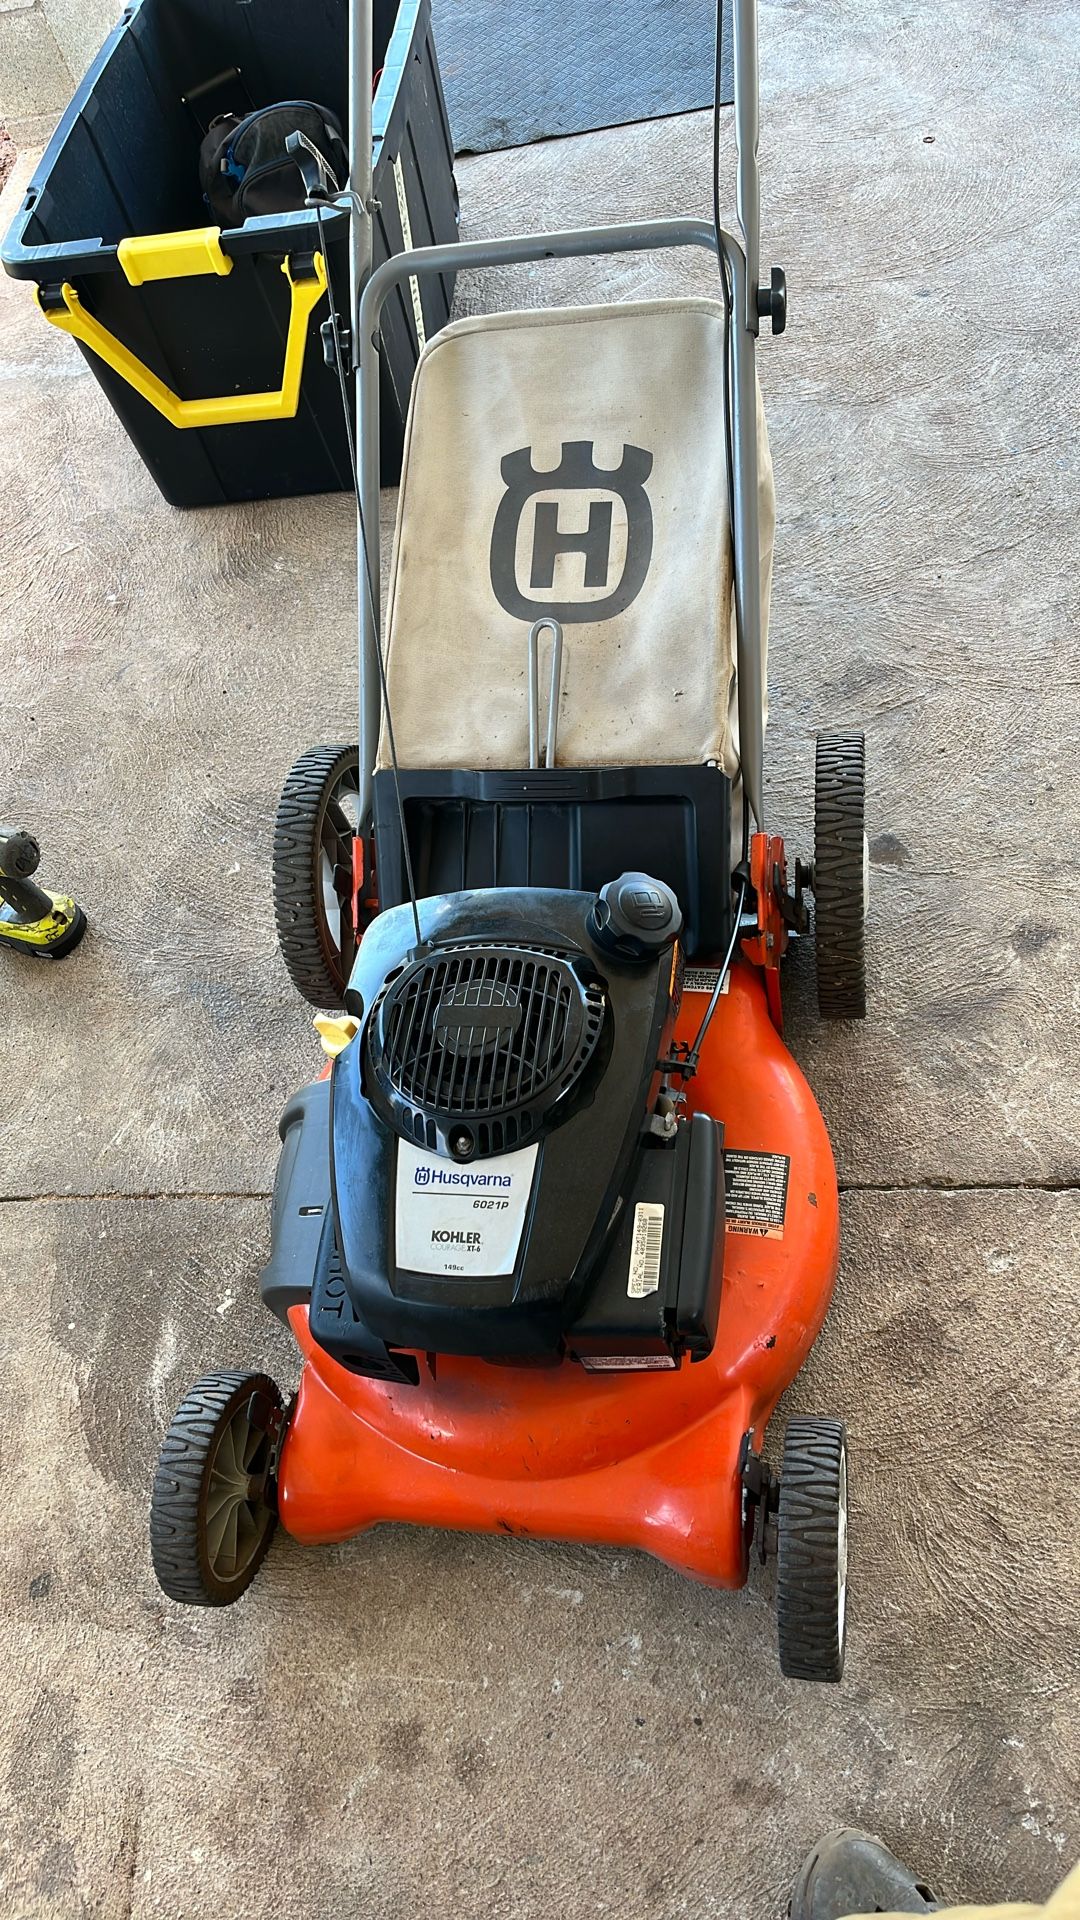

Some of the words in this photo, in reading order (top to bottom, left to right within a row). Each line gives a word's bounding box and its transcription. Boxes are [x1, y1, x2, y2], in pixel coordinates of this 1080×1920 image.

[530, 501, 613, 588] H
[431, 1169, 512, 1187] Husqvarna
[472, 1200, 510, 1210] 6021P
[431, 1230, 481, 1244] KOHLER
[727, 1225, 759, 1235] WARNING
